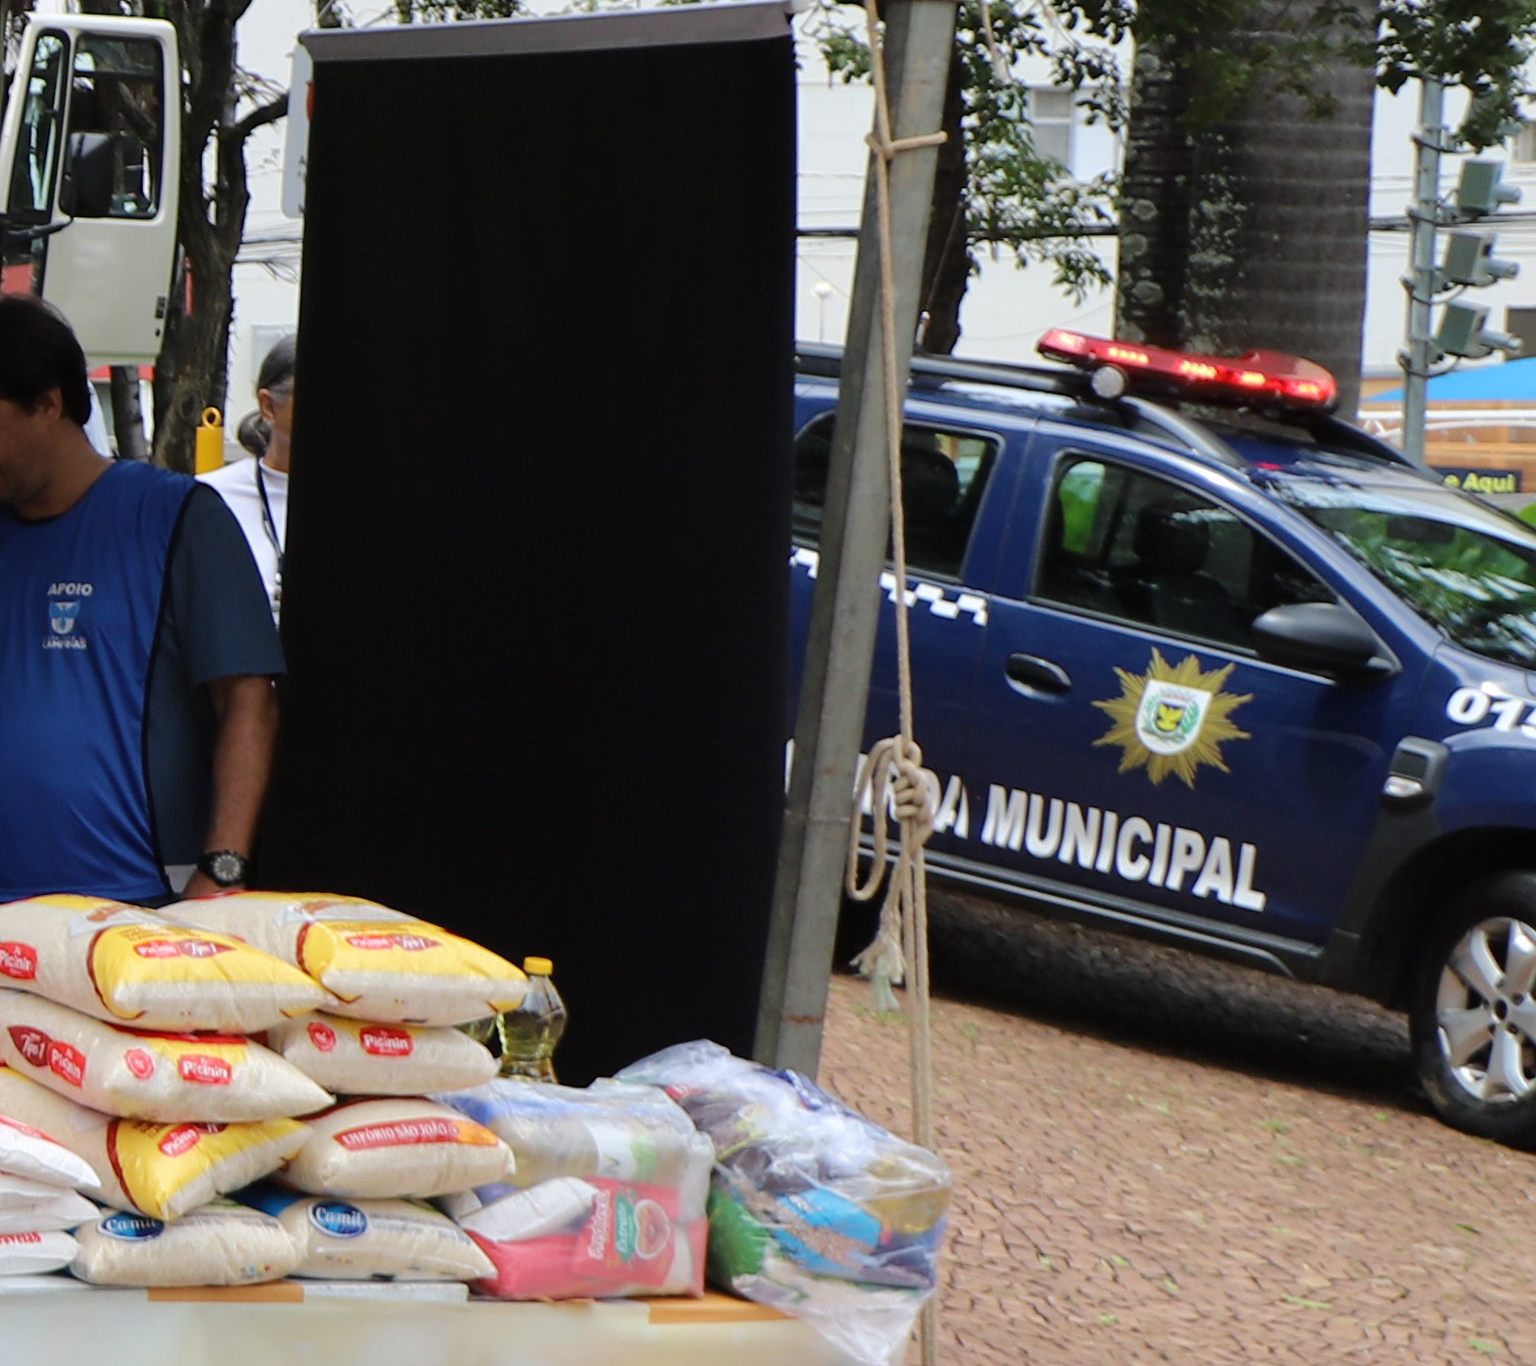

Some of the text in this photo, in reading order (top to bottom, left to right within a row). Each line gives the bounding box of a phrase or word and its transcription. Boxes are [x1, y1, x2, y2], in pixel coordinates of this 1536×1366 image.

[1462, 472, 1517, 494] Aqui
[47, 583, 93, 597] APOIO
[981, 783, 1267, 912] MUNICIPAL
[182, 1059, 228, 1078] Picinin
[316, 1207, 363, 1227] Camil
